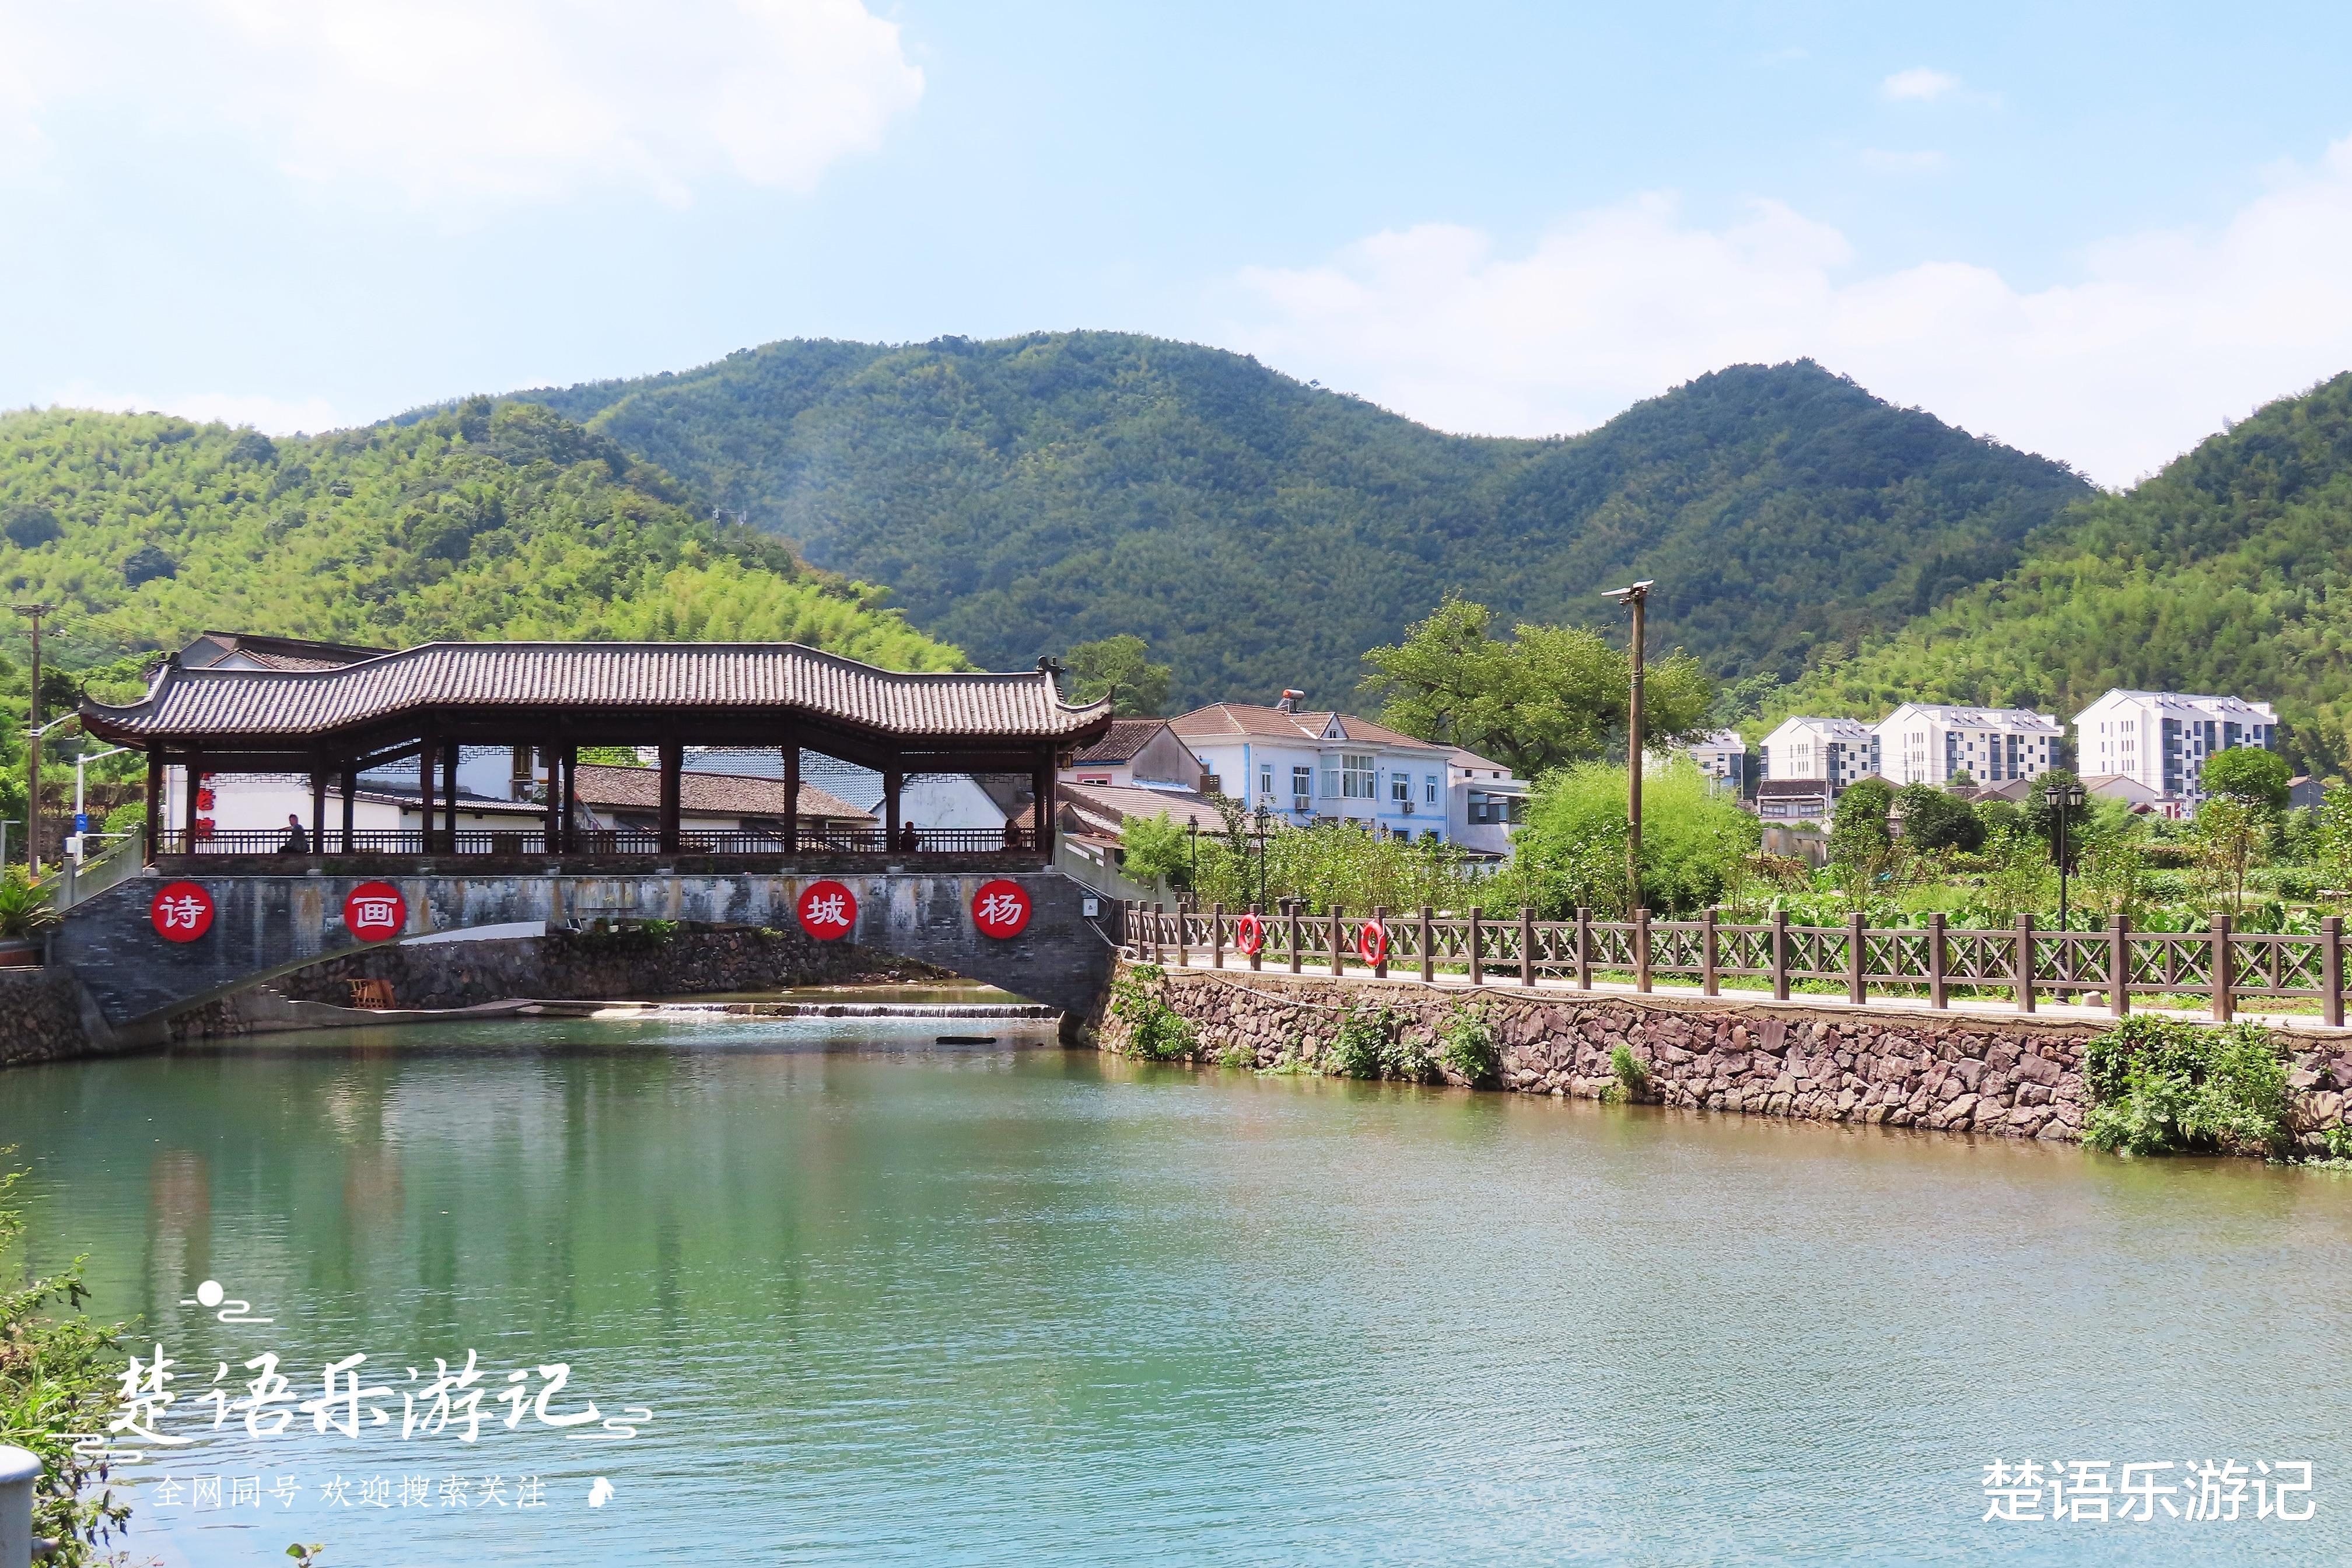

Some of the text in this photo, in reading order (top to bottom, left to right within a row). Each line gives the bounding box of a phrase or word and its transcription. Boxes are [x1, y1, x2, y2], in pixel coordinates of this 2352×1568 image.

[159, 893, 1022, 928] 诗 画 城 杨
